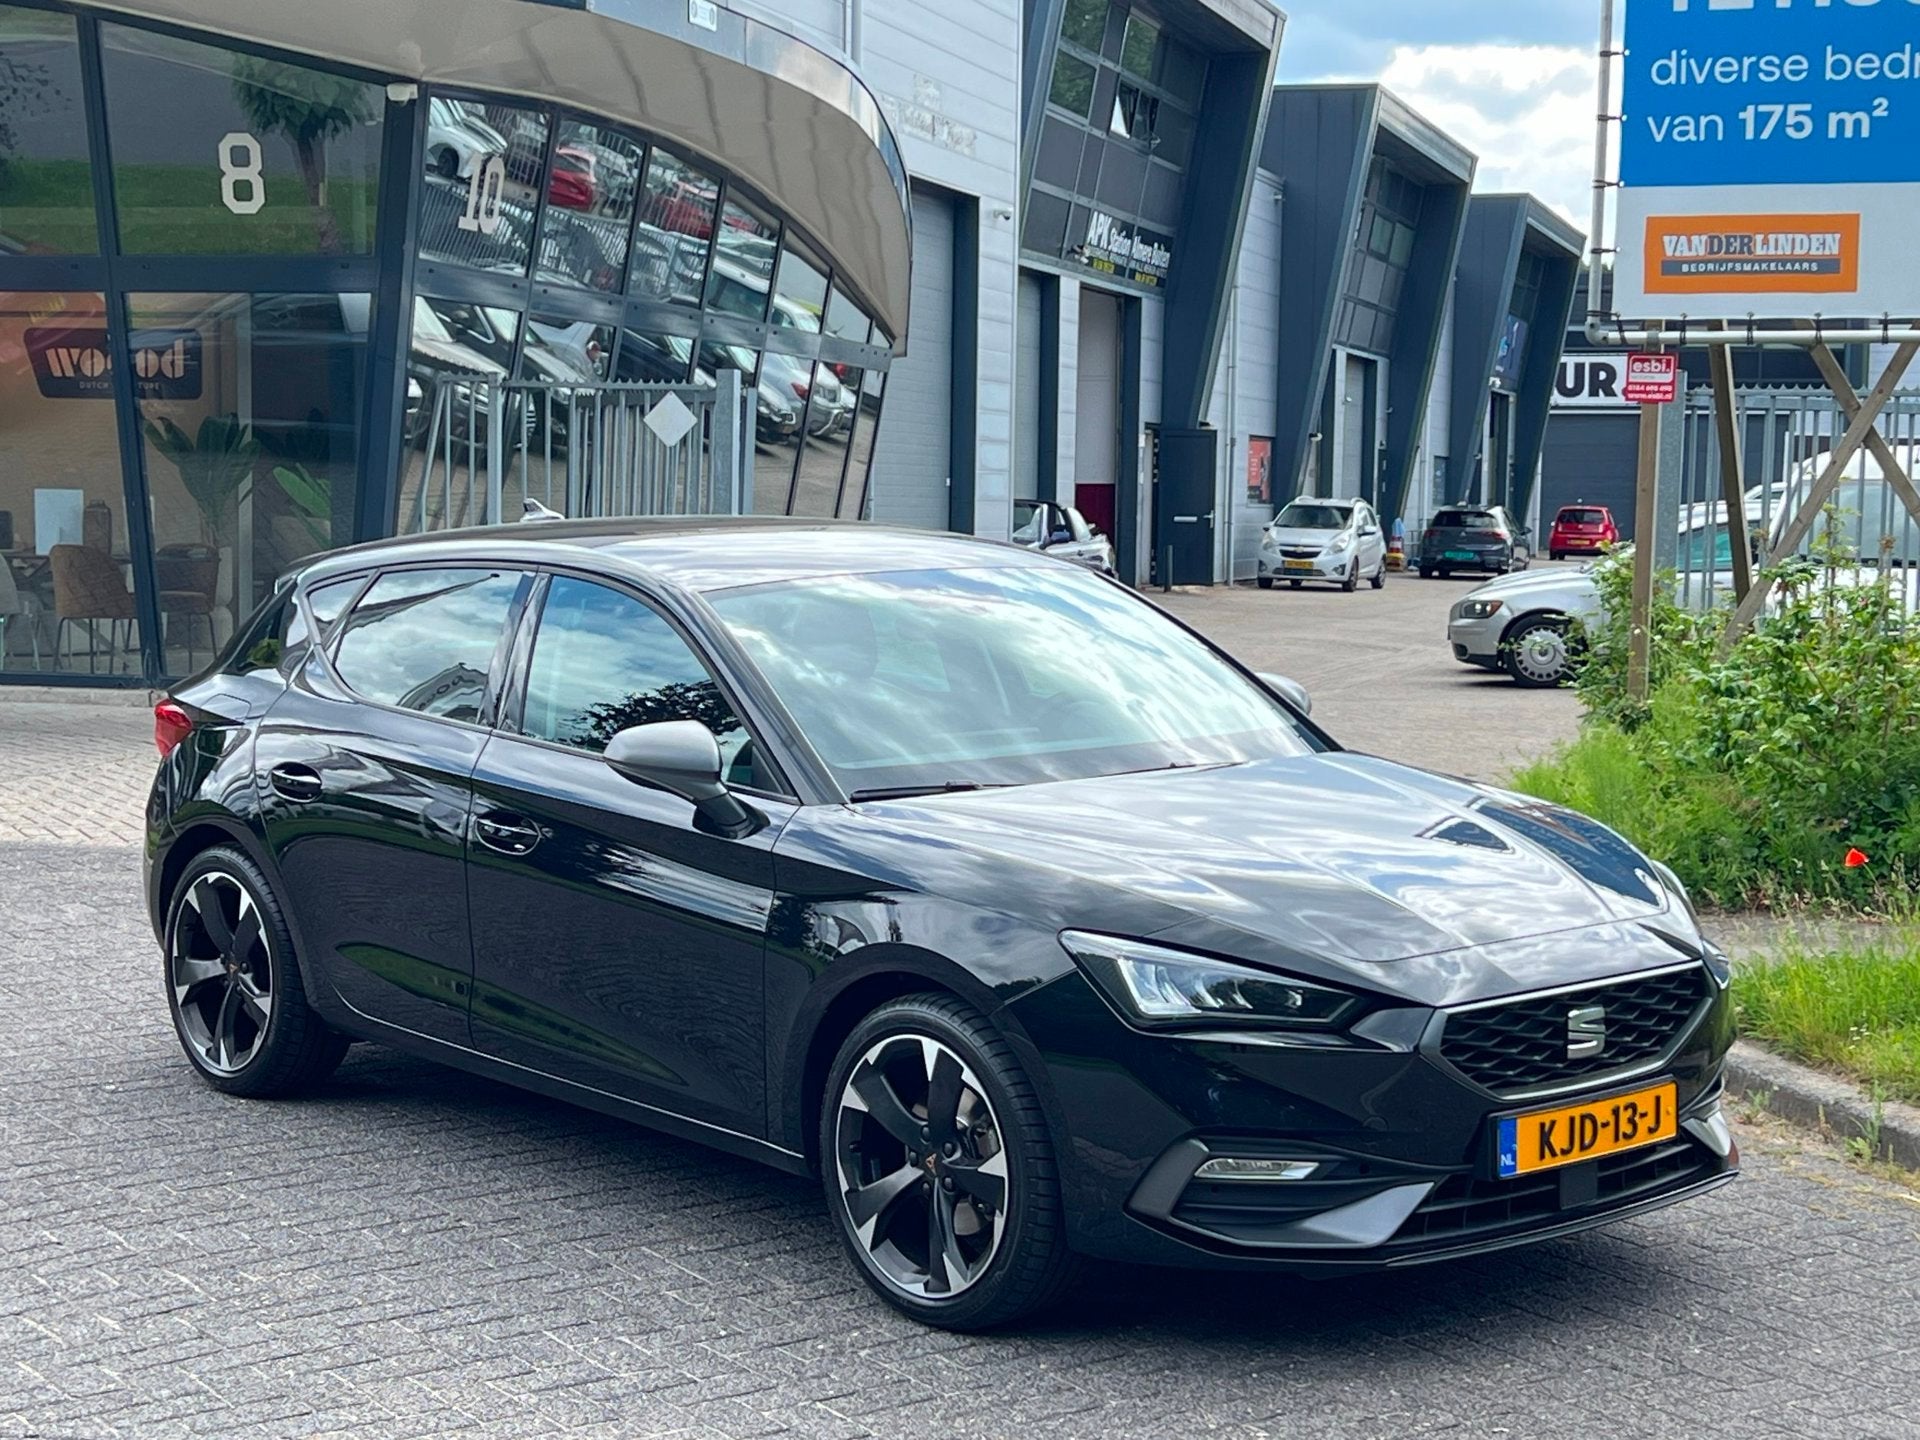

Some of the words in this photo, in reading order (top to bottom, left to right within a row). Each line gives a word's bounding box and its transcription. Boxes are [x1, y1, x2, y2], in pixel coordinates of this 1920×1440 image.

[1650, 49, 1809, 85] diverse
[1648, 113, 1723, 142] van
[1738, 104, 1813, 140] 175
[218, 132, 266, 214] 8
[458, 152, 506, 235] 10
[1087, 210, 1112, 249] APK
[1681, 262, 1818, 273] BEDRIJFSMAKELAARS
[1538, 1094, 1662, 1162] KJD-13-J
[1500, 1154, 1515, 1166] NL
